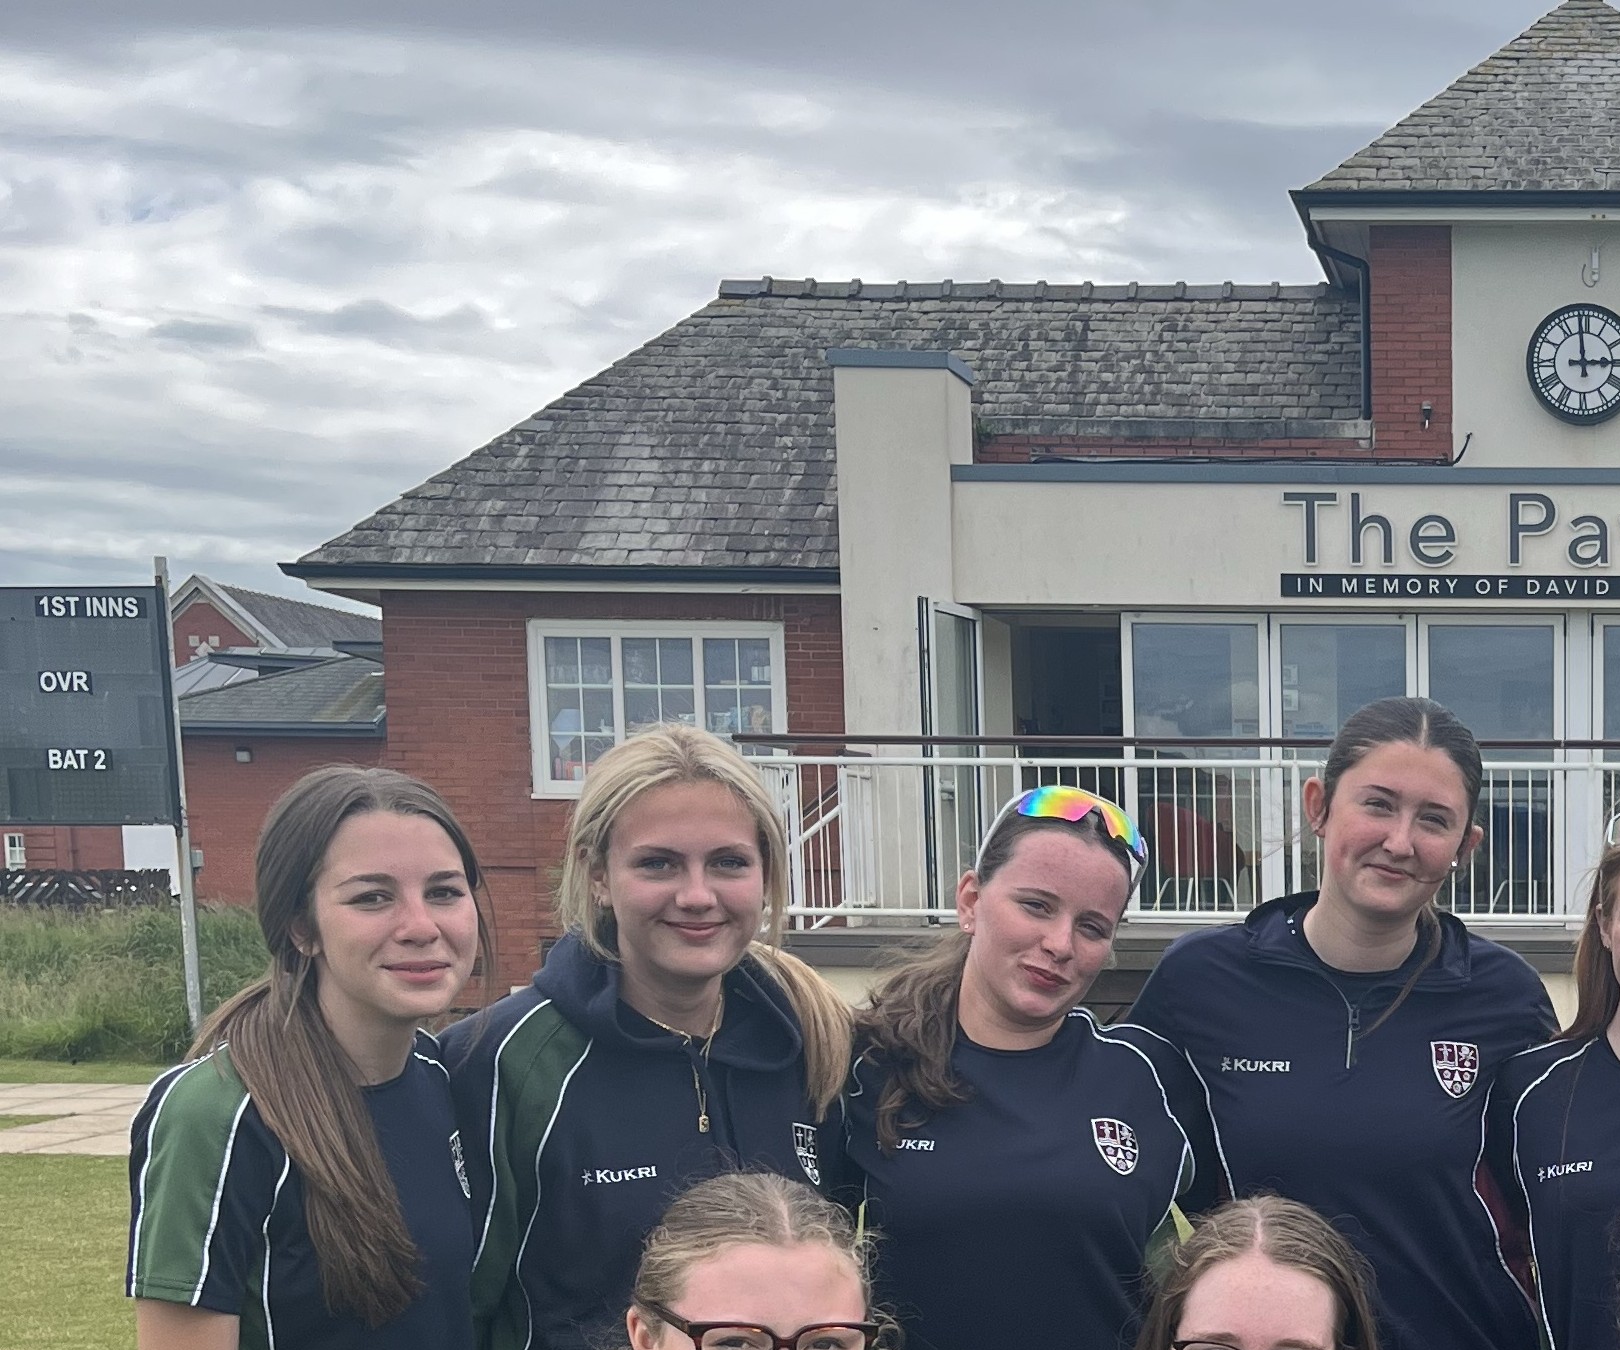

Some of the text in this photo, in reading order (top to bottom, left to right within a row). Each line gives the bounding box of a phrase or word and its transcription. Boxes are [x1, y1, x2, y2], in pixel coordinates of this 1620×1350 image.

[1282, 491, 1457, 566] The
[1296, 577, 1323, 593] IN
[1341, 577, 1459, 594] MEMORY
[1475, 578, 1509, 595] OF
[1526, 579, 1609, 595] DAVID
[39, 596, 139, 618] 1ST INNS
[39, 671, 90, 692] OVR
[48, 749, 106, 770] BAT 2
[1233, 1058, 1291, 1072] KUKRI
[895, 1138, 936, 1151] UKRI
[595, 1165, 658, 1184] KUKRI
[1547, 1160, 1594, 1179] KUKRI
